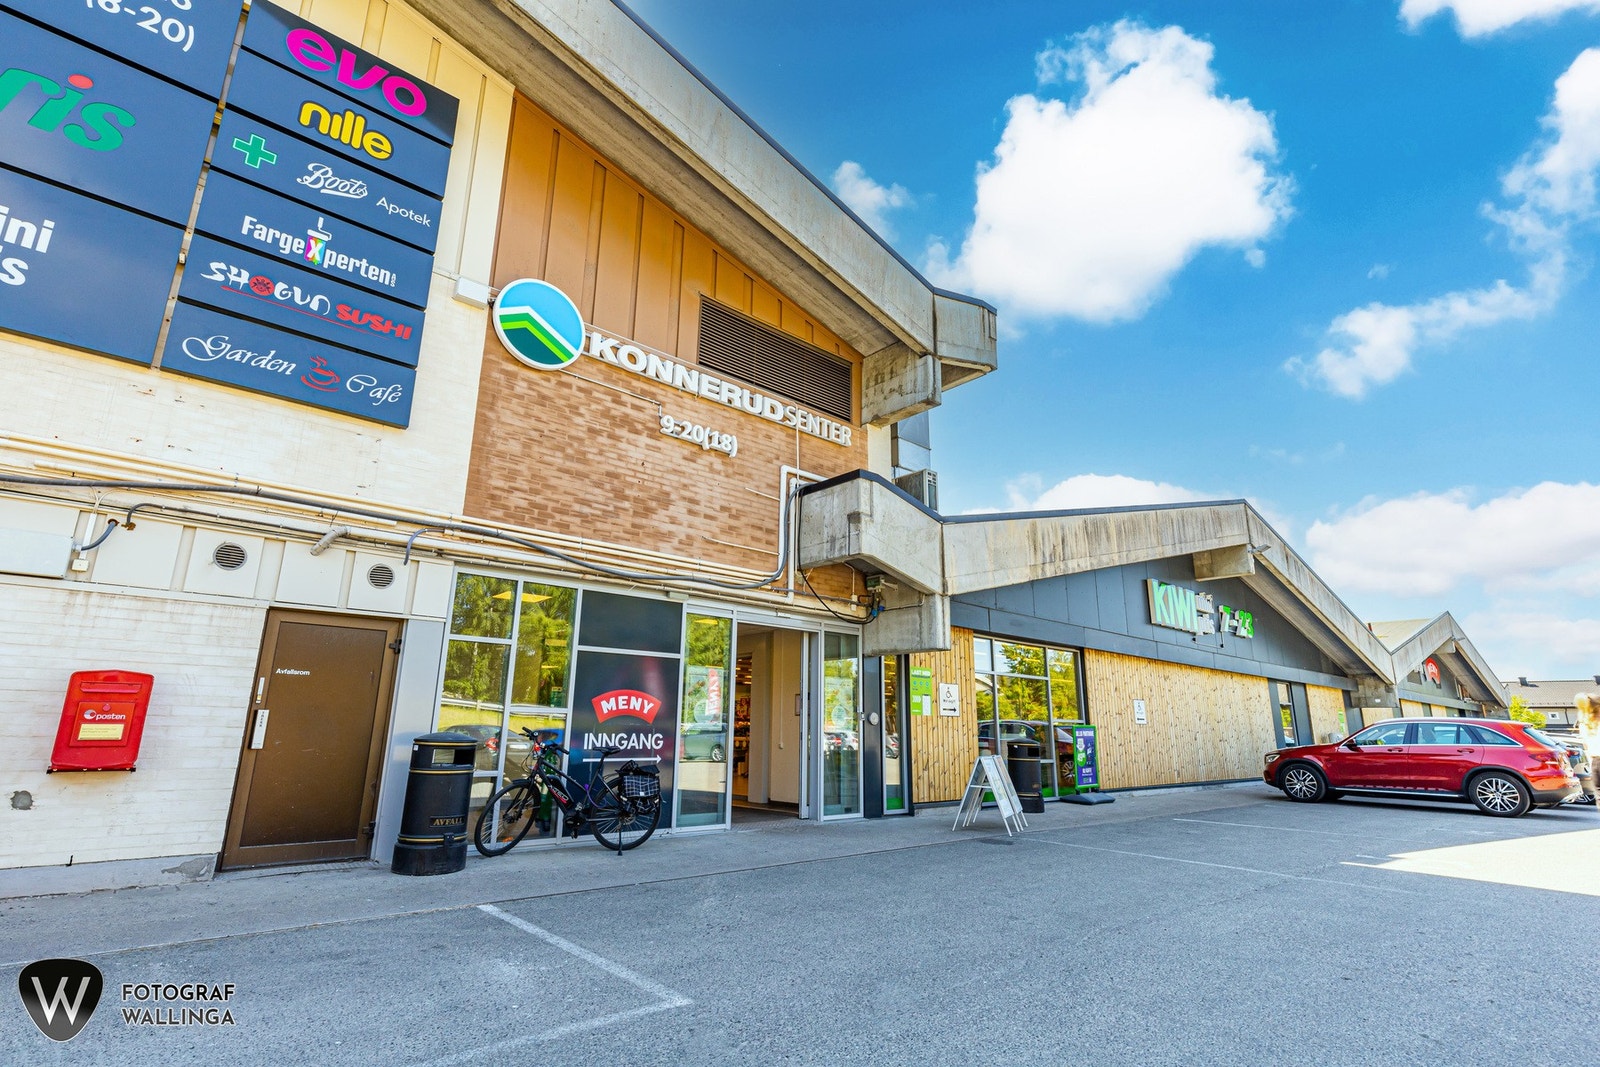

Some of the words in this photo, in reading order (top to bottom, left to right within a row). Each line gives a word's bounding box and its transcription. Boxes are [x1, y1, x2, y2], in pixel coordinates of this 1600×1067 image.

[285, 27, 428, 117] evo
[299, 100, 394, 160] nille
[296, 162, 368, 199] Boots
[375, 196, 432, 228] Apotek
[335, 303, 413, 341] SUSHI
[181, 334, 297, 376] Garden
[345, 373, 403, 406] Café
[659, 414, 738, 458] 9-20(18)
[1146, 577, 1199, 635] KIWI
[275, 668, 311, 676] Avfallsrom
[95, 713, 126, 721] posten
[600, 695, 655, 714] MENY
[583, 732, 664, 750] INNGANG
